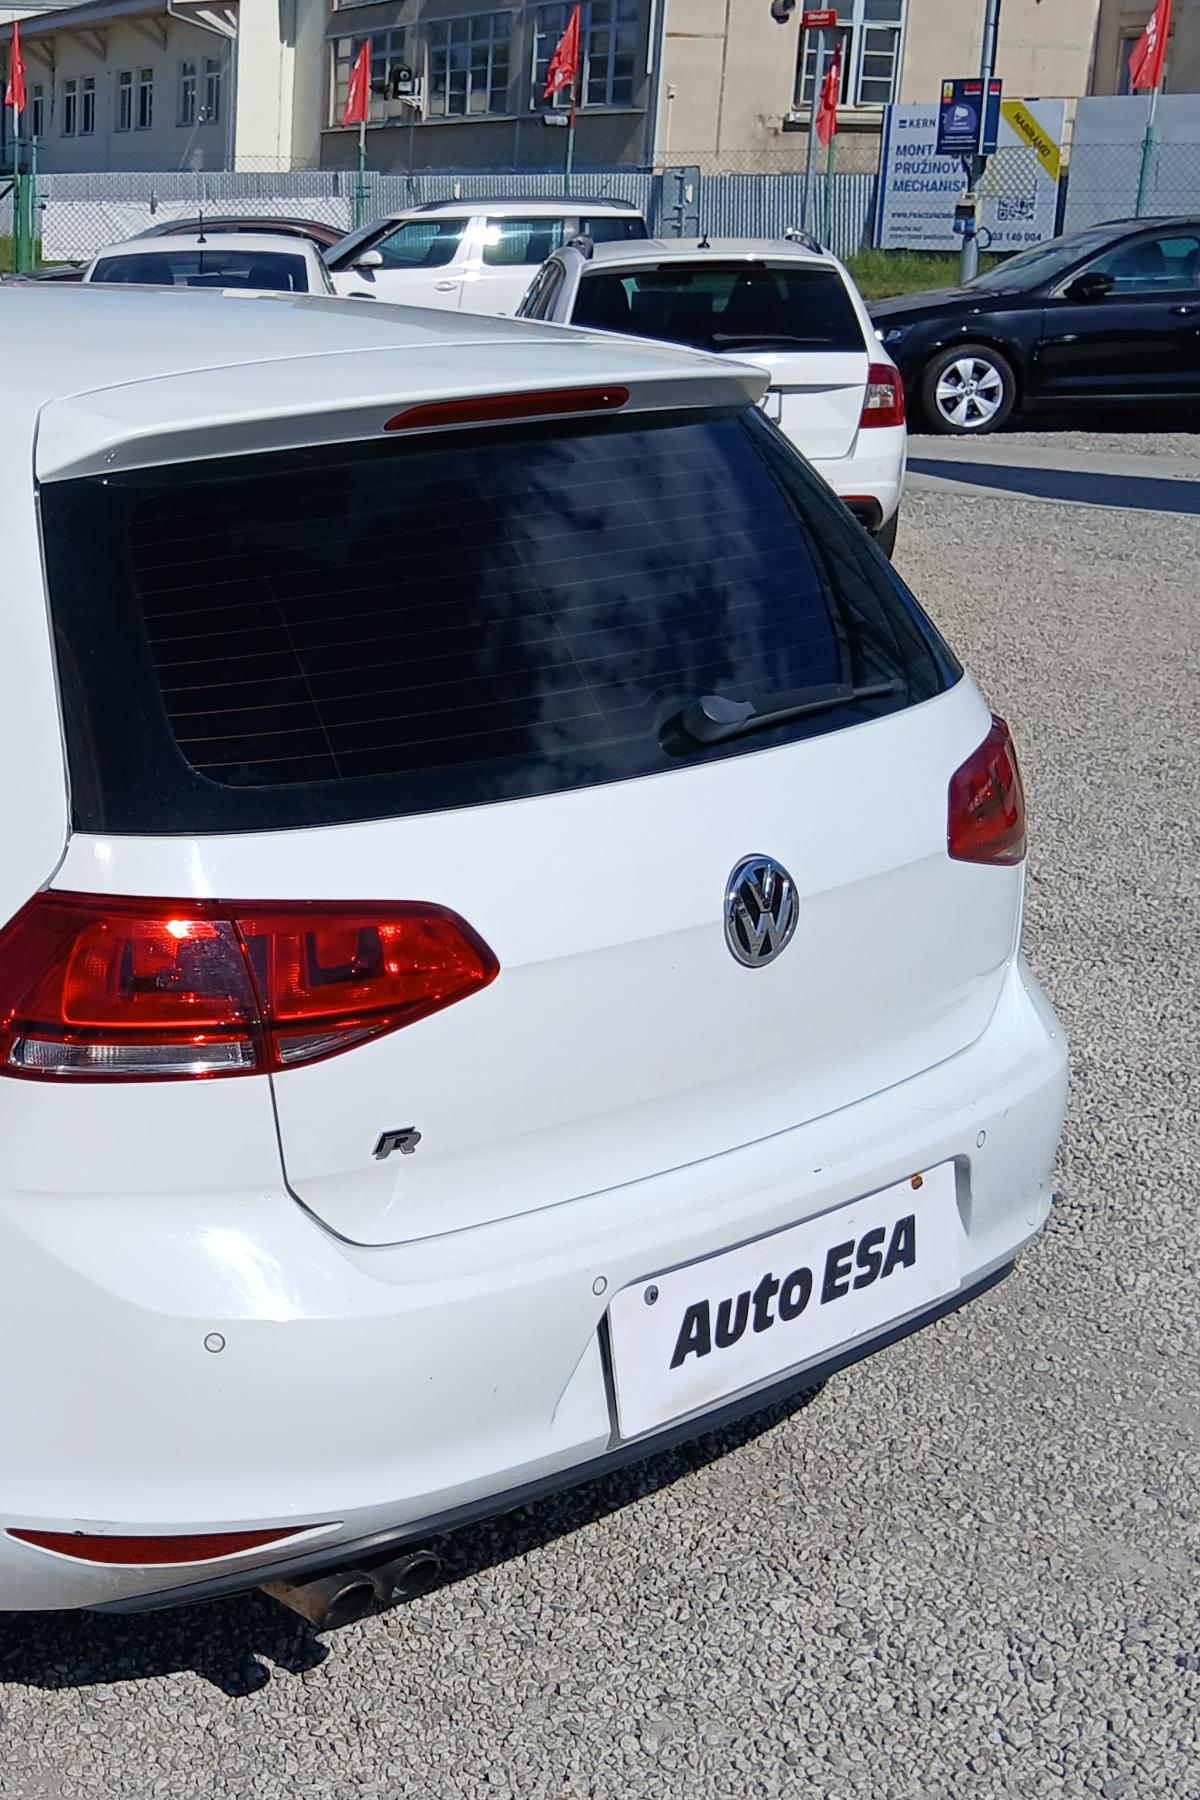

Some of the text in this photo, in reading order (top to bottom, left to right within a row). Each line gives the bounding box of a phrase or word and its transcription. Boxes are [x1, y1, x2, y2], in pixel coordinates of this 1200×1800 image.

[896, 144, 935, 157] MONT
[894, 158, 961, 174] PRUŽINOV
[372, 1126, 422, 1160] R
[669, 1213, 916, 1370] Auto ESA
